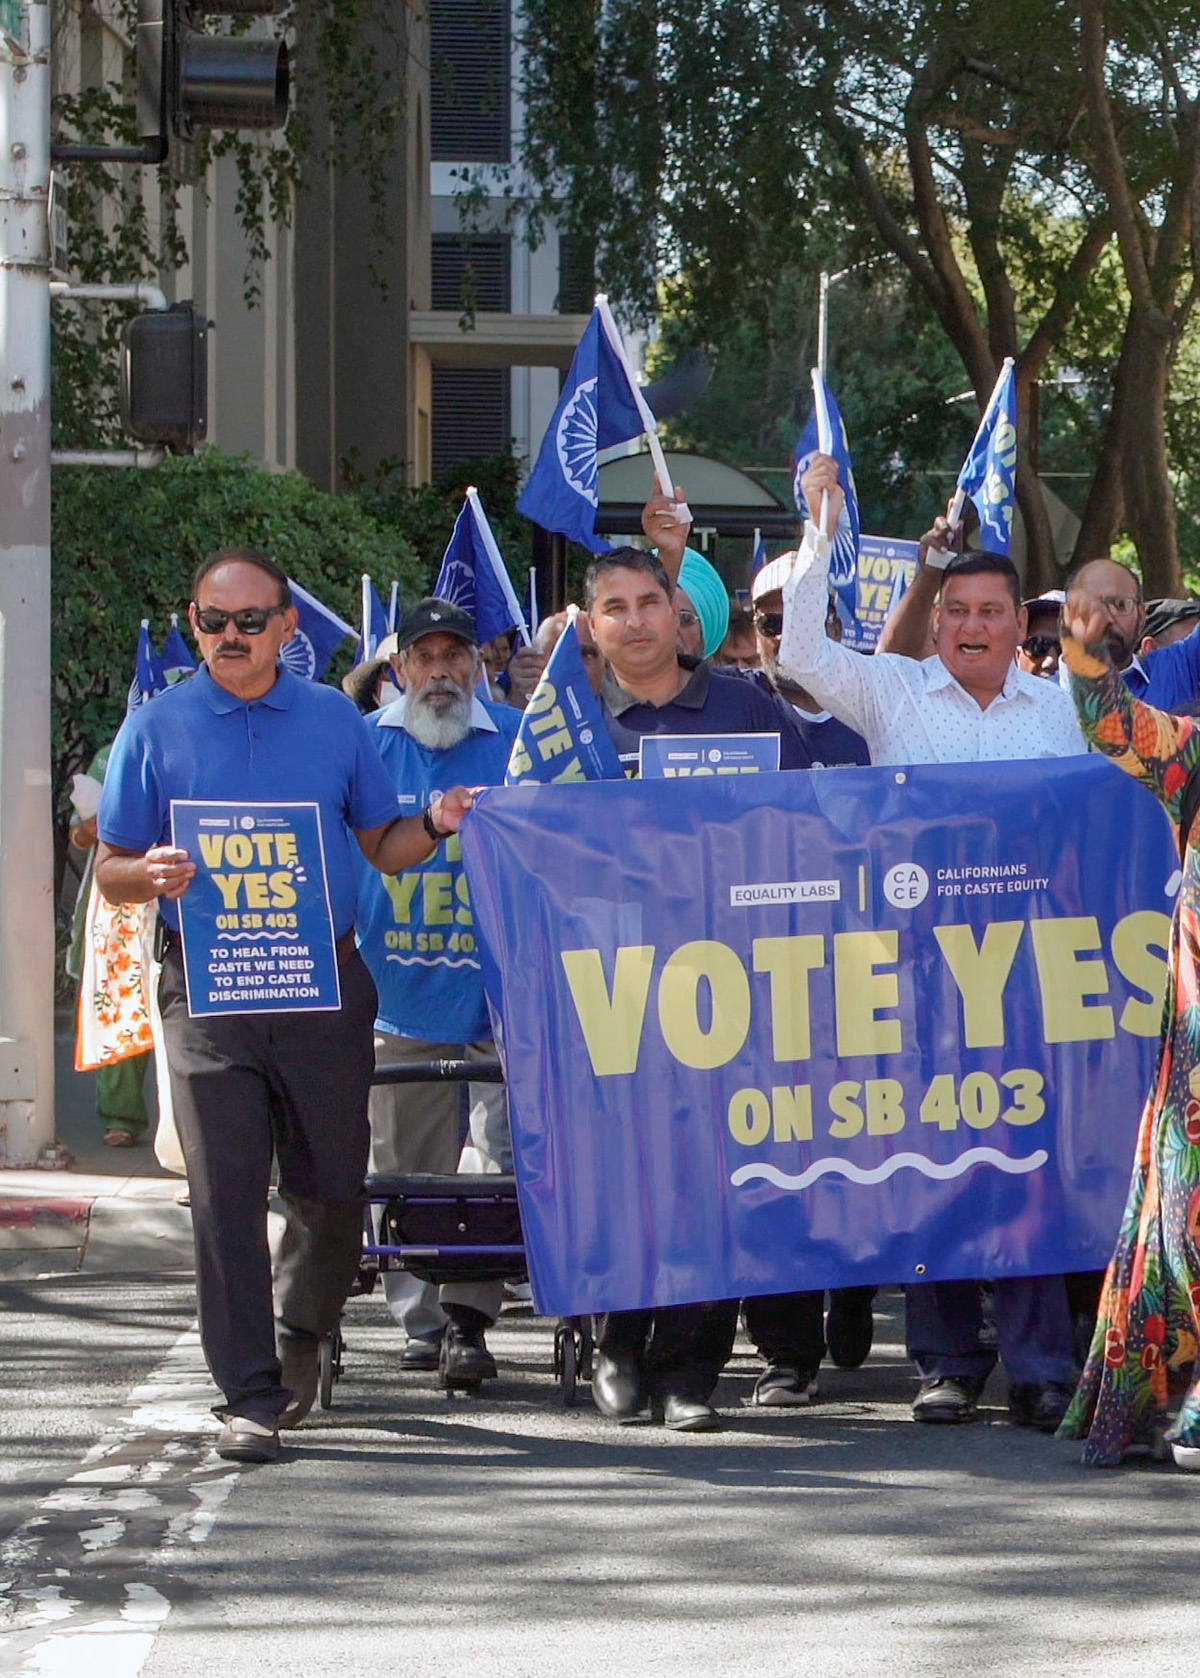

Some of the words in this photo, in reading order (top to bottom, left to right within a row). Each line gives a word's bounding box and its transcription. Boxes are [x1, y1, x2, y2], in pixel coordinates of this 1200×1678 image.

[859, 582, 892, 611] YE
[198, 833, 299, 868] VOTE
[937, 864, 1027, 880] CALIFORNIANS
[211, 871, 298, 909] YES
[735, 887, 797, 902] EQUALITY
[801, 884, 836, 898] LABS
[937, 884, 961, 897] FOR
[964, 882, 1004, 896] CASTE
[1007, 878, 1050, 893] EQUITY
[216, 914, 239, 930] ON
[241, 914, 263, 929] SB
[265, 913, 298, 929] 403
[384, 931, 412, 950] ON
[416, 934, 444, 951] SB
[447, 933, 475, 952] 40
[210, 948, 229, 959] TO
[232, 947, 267, 958] HEAL
[271, 946, 309, 957] FROM
[208, 962, 251, 973] CASTE
[254, 961, 275, 971] WE
[279, 959, 314, 970] NEED
[214, 976, 232, 987] TO
[236, 974, 265, 986] END
[268, 973, 311, 984] CASTE
[208, 987, 319, 1002] DISCRIMINATION
[561, 930, 902, 1077] VOTE
[933, 909, 1173, 1048] YES
[727, 1084, 814, 1146] ON
[828, 1079, 905, 1139] SB
[918, 1068, 1045, 1131] 403
